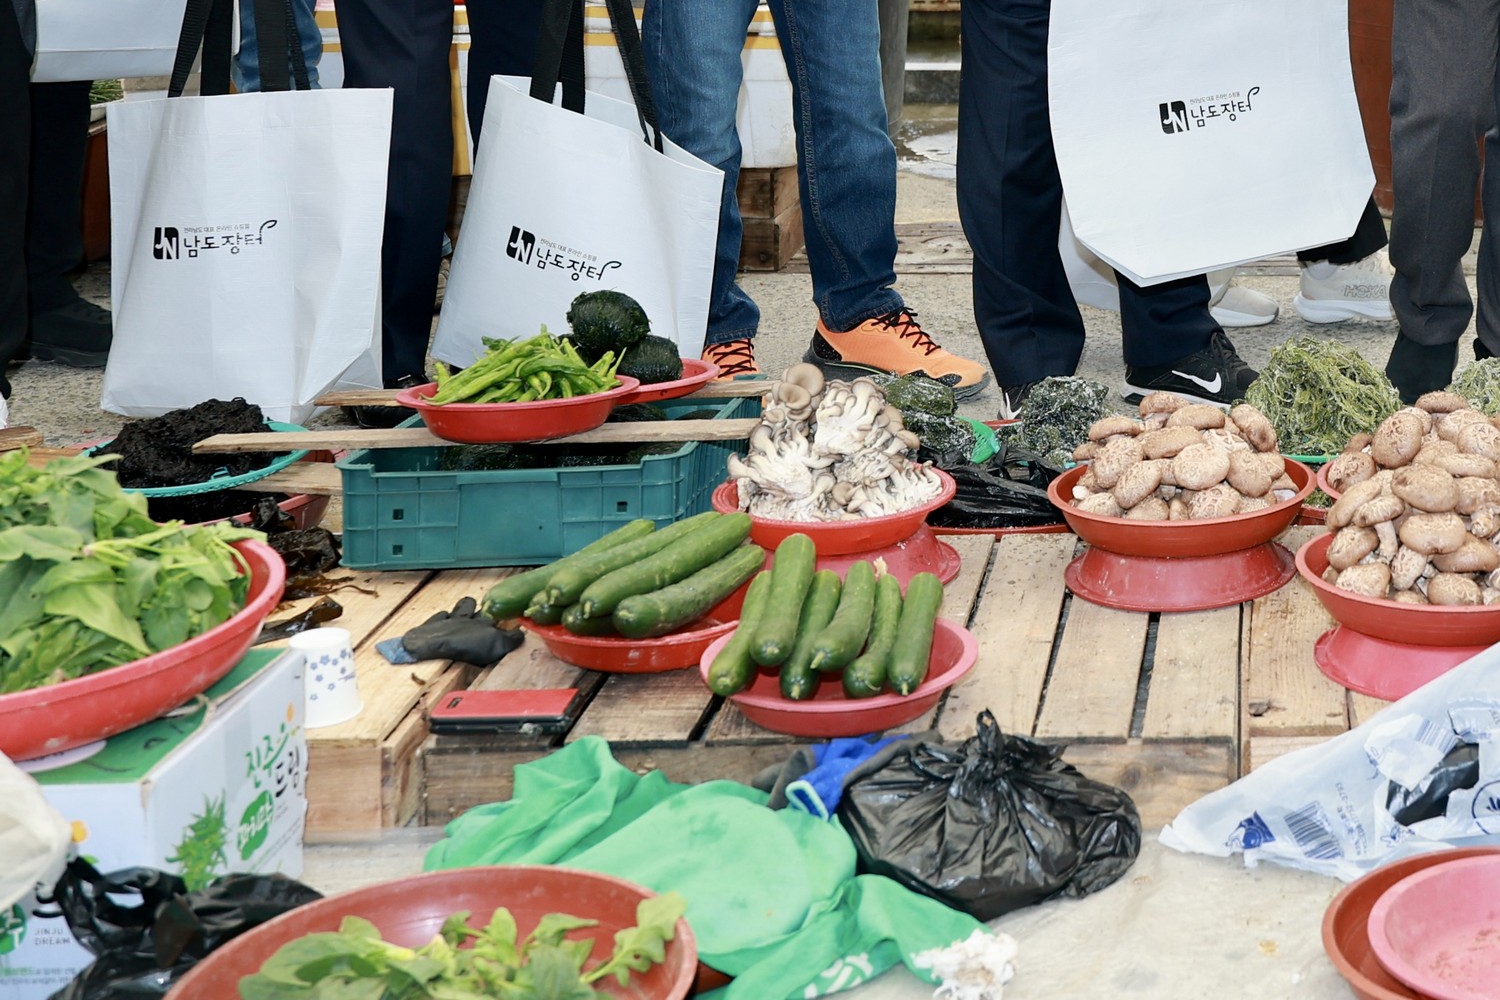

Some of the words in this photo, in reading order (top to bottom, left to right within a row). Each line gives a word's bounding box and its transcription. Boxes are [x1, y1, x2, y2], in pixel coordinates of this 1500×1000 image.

[1191, 86, 1260, 127] 남도장터
[184, 220, 277, 258] 남도장터
[537, 248, 622, 281] 남도장터
[1344, 284, 1388, 299] HOKA
[34, 927, 64, 935] JINJU
[34, 937, 71, 946] DREAM
